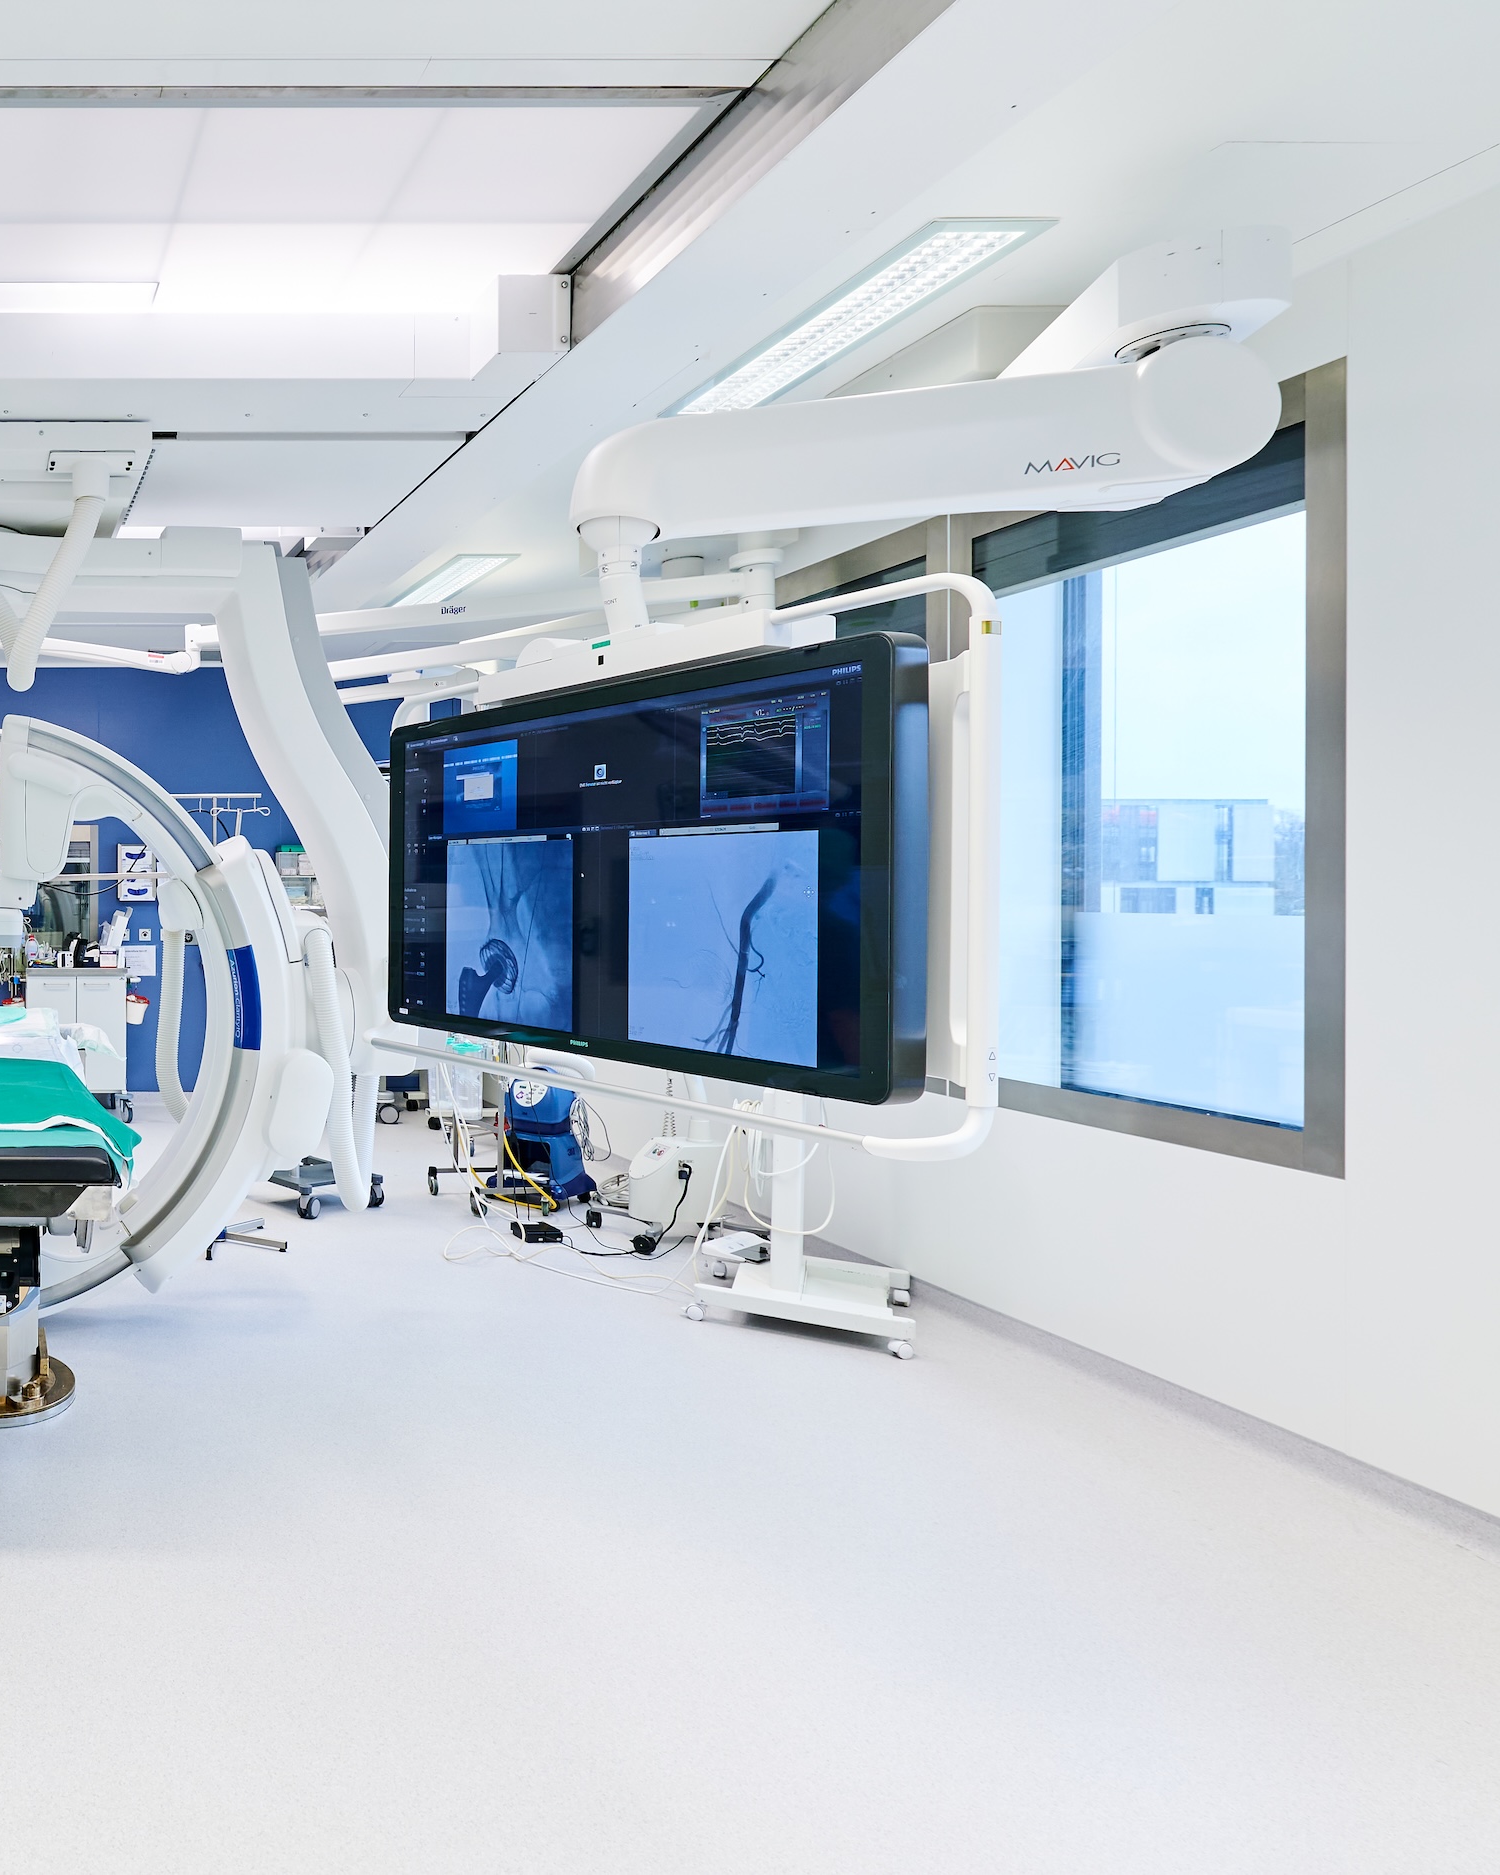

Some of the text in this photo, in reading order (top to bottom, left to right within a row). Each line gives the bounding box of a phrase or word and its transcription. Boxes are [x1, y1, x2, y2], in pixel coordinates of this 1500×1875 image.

[1024, 452, 1121, 475] MAVIG
[441, 605, 467, 615] Dräger
[832, 664, 862, 676] PHILIPS
[229, 959, 239, 996] Azurion
[569, 1039, 589, 1048] PHILIPS
